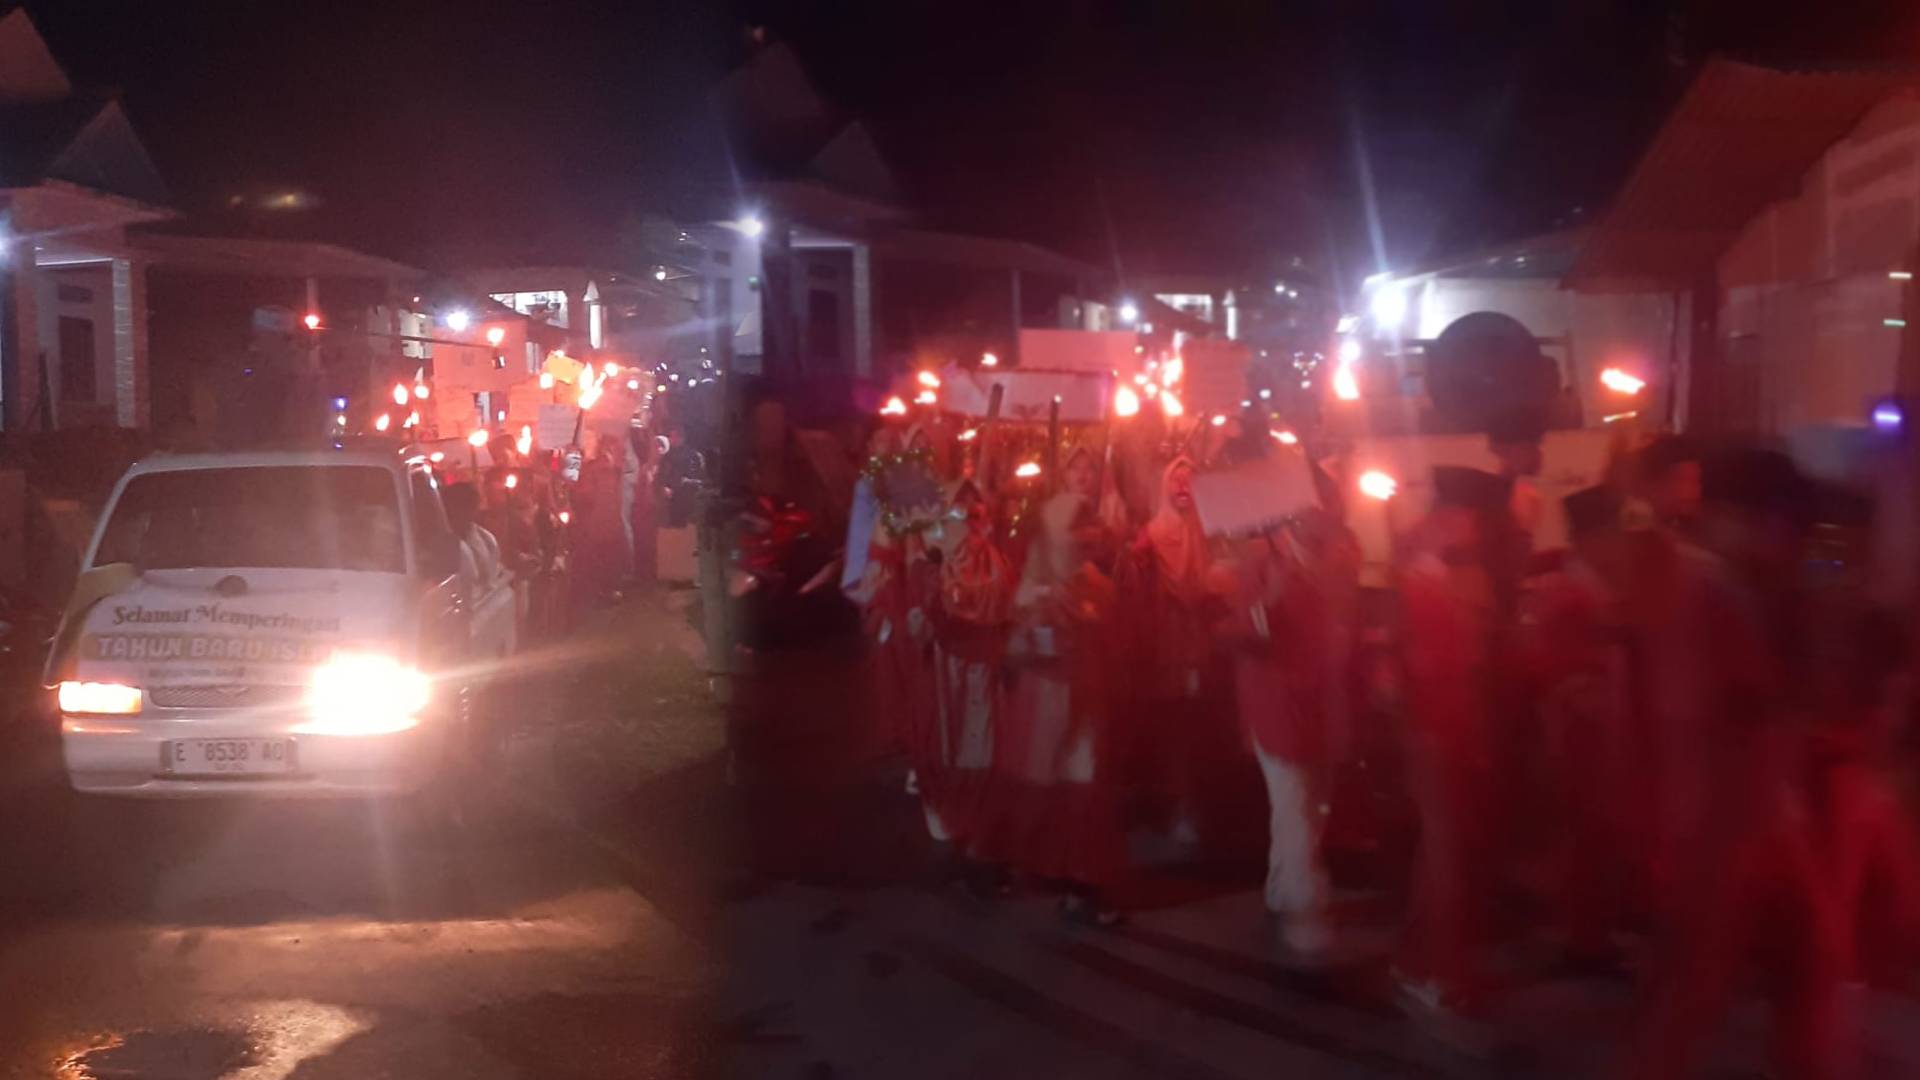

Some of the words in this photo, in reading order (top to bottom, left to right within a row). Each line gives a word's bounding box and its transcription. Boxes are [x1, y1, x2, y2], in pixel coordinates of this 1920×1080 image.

[112, 605, 192, 626] Selamat
[98, 636, 182, 657] TAHUN
[190, 637, 267, 658] BARU
[175, 742, 186, 762] E
